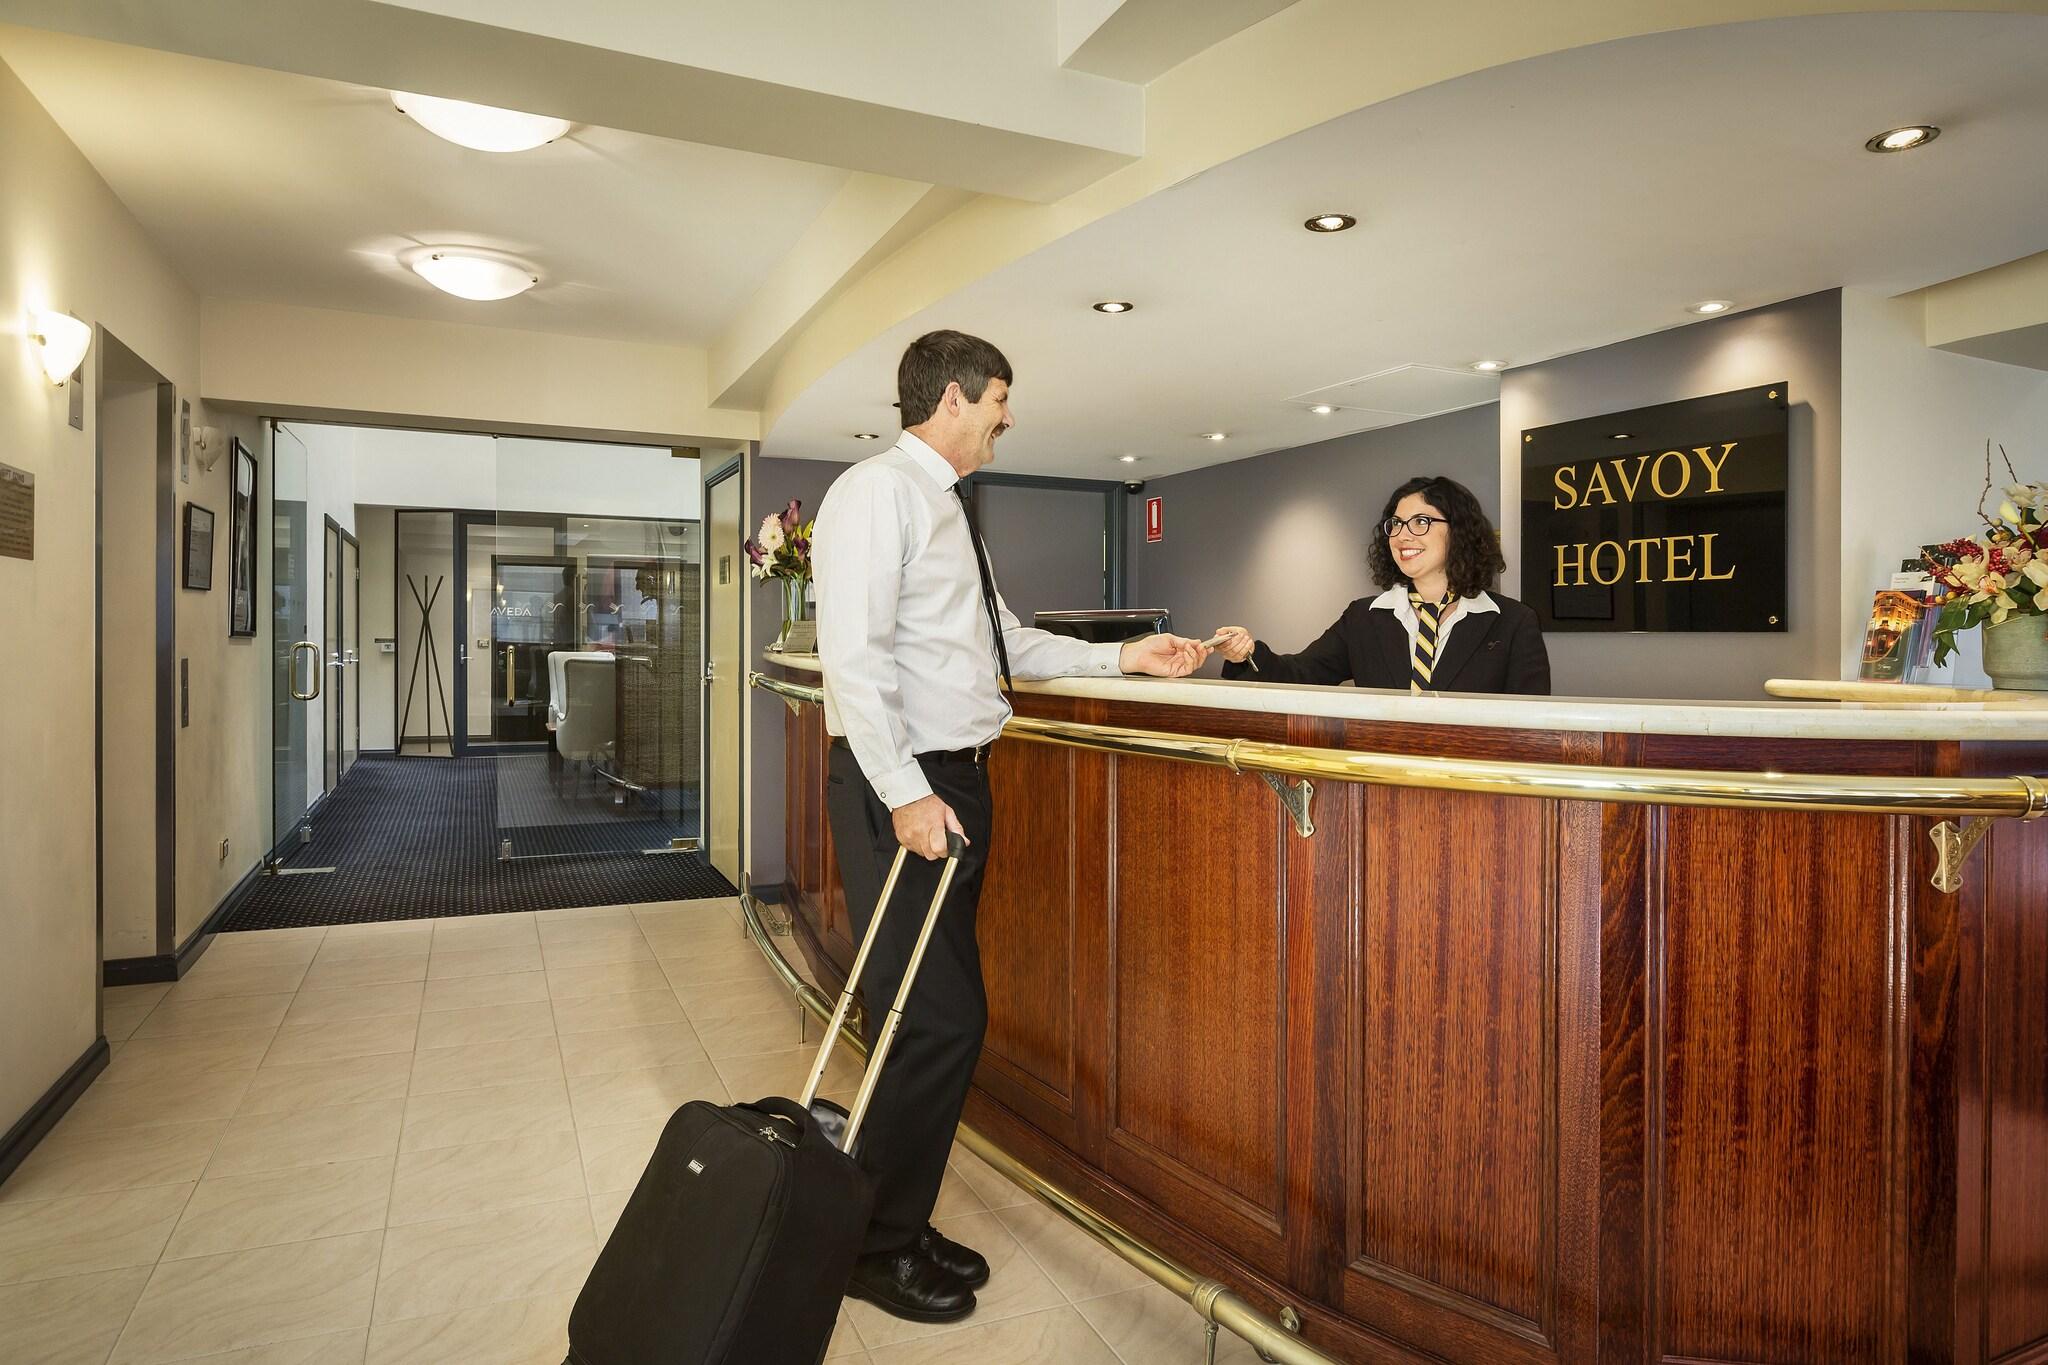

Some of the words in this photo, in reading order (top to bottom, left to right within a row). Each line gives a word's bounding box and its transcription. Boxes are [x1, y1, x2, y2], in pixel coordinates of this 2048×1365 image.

[1554, 443, 1738, 510] SAVOY
[1553, 533, 1735, 587] HOTEL
[490, 606, 532, 616] AVEDA
